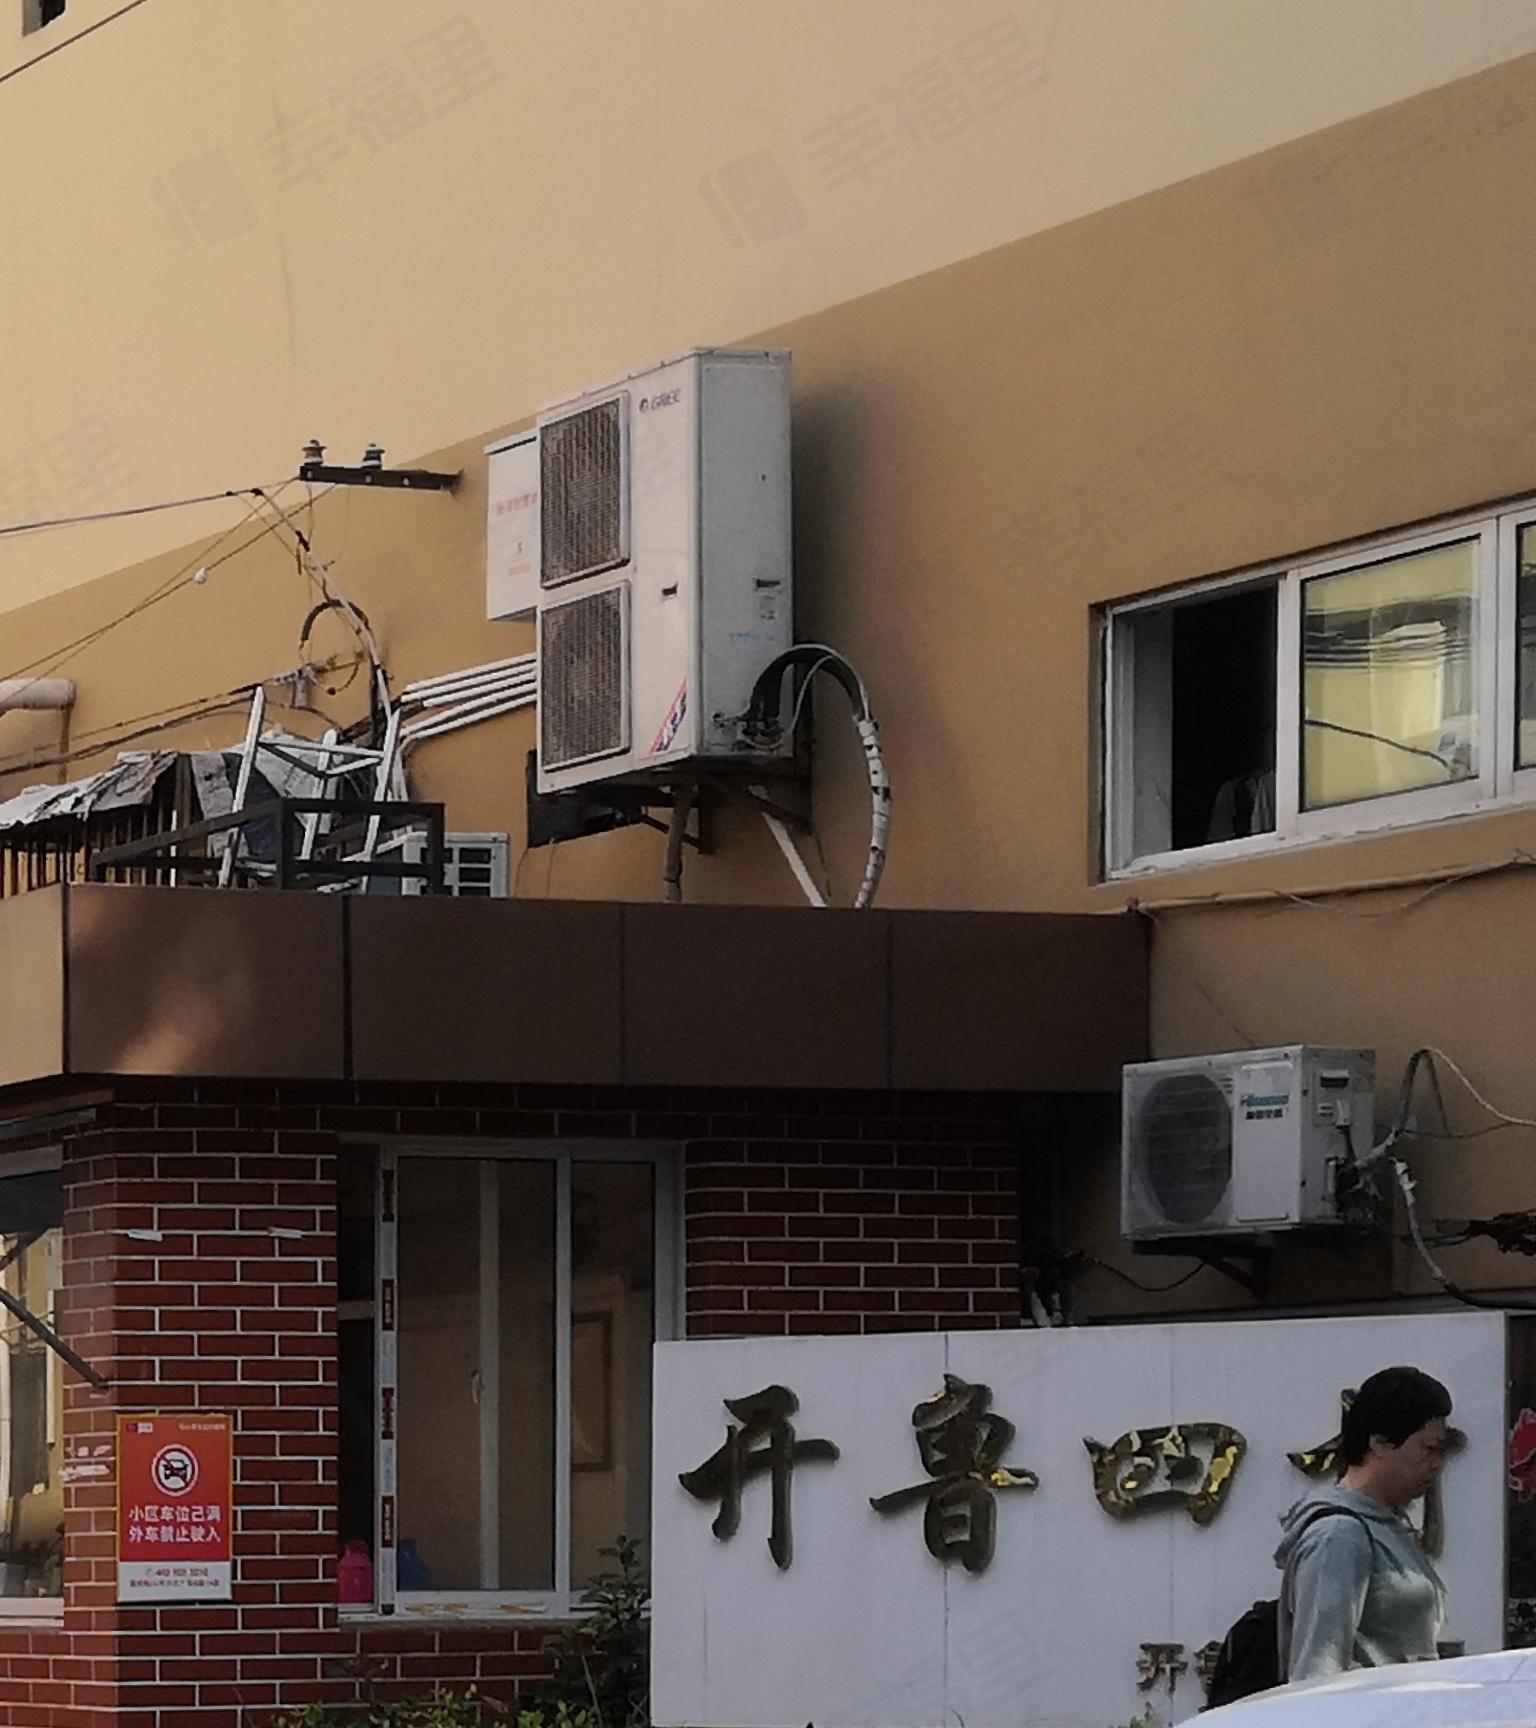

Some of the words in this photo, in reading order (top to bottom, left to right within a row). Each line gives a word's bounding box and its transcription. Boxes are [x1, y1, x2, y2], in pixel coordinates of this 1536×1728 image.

[129, 1526, 221, 1543] 外车禁止驶入
